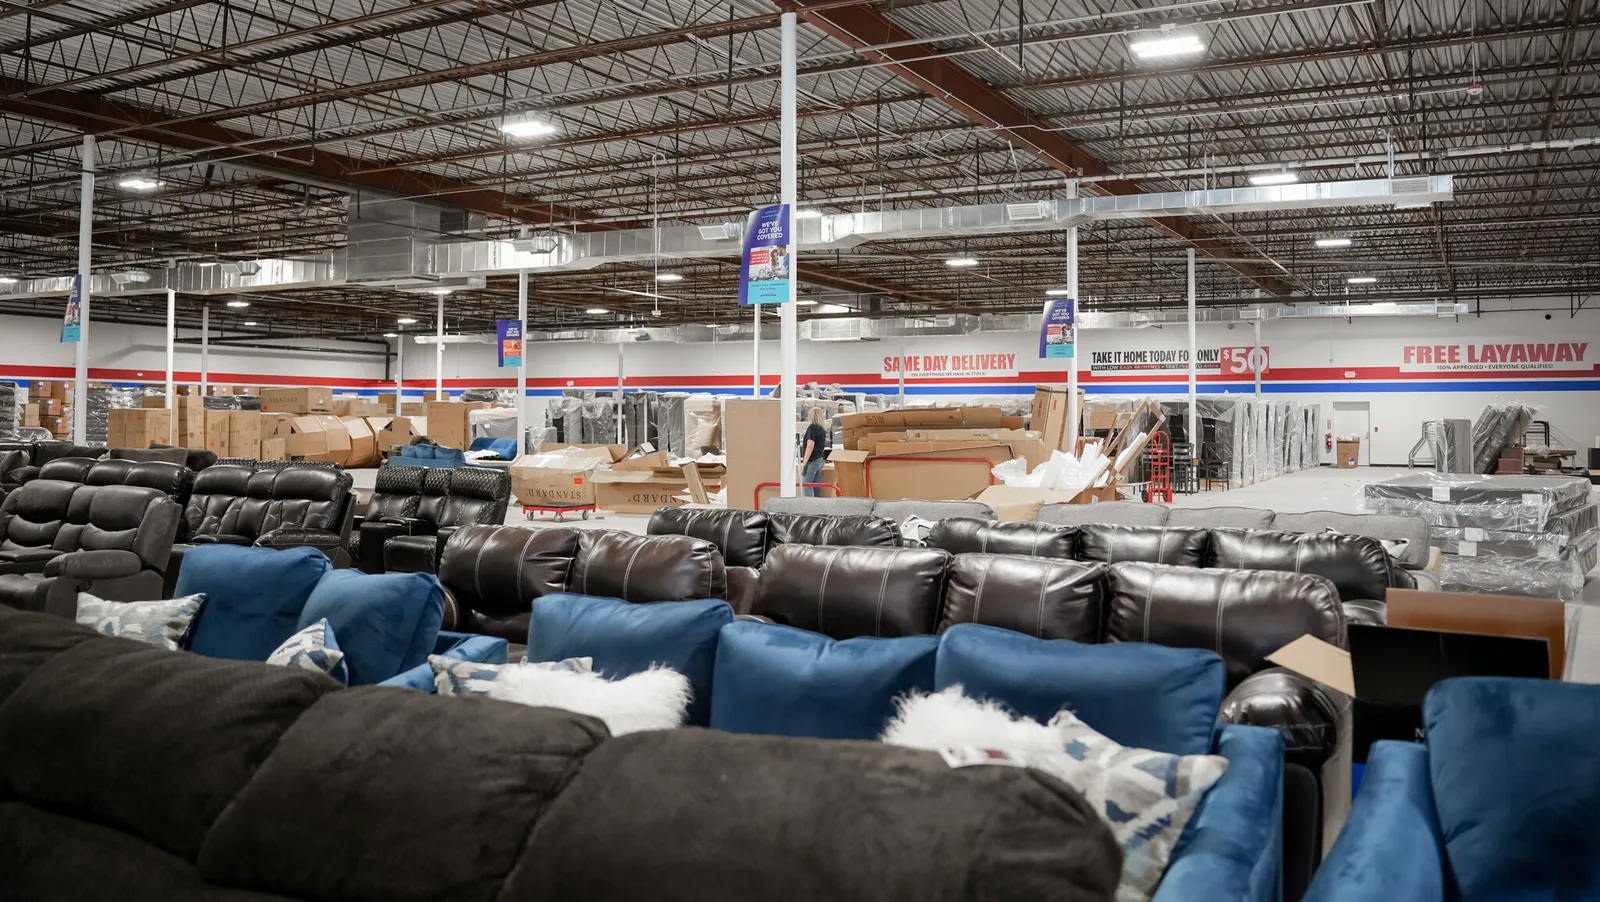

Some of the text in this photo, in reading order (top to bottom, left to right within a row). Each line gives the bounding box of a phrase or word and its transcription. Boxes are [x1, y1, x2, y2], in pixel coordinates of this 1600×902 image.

[756, 232, 783, 241] COVERED
[1092, 349, 1220, 364] TAKE IT HOME TODAY FO ONLY
[1403, 343, 1588, 364] FREE LAYAWAY
[883, 353, 1016, 372] SAME DAY DELIVERY
[528, 488, 582, 500] STANDARD
